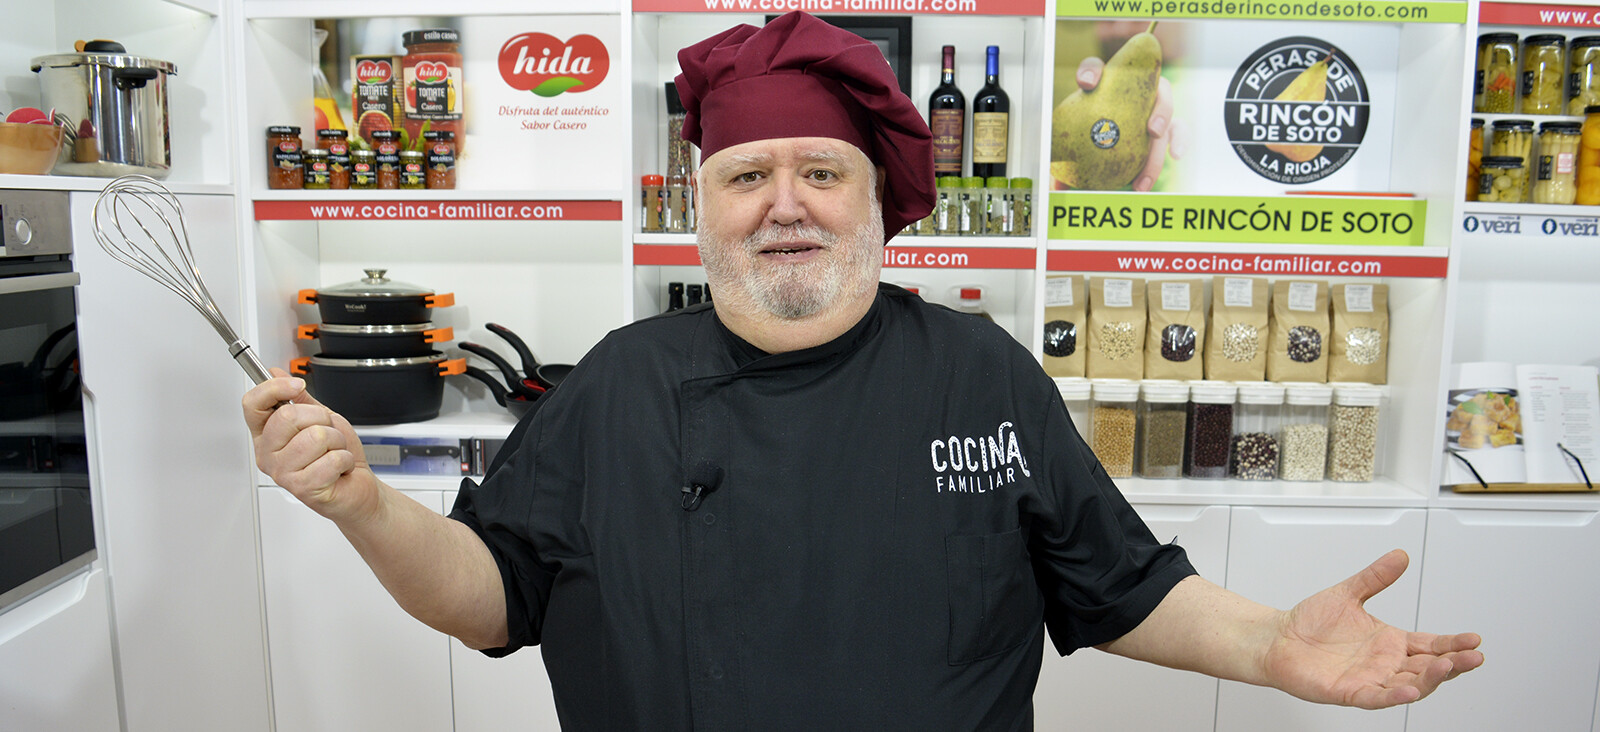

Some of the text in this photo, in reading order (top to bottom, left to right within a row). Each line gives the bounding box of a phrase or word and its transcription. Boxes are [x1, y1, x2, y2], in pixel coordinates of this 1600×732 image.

[1094, 0, 1428, 18] www.perasderincondesoto.com
[512, 45, 594, 75] hida
[359, 66, 387, 77] hida
[419, 66, 443, 77] hida
[1245, 49, 1354, 93] PERAS DE
[359, 85, 388, 96] TOMATE
[418, 87, 445, 98] TOMATE
[361, 101, 387, 110] Casero
[420, 103, 443, 111] Casero
[498, 105, 609, 118] Disfruta del auténtico
[1239, 100, 1356, 127] RINCÓN
[520, 119, 587, 130] Sabor Casero
[1252, 125, 1342, 143] DE SOTO
[1259, 154, 1332, 176] LA RIOJA
[309, 203, 564, 219] www.cocina-familiar.com
[1052, 203, 1414, 235] PERAS DE RINCÓN DE SOTO
[1481, 216, 1521, 234] veri
[1559, 218, 1599, 236] veri
[1117, 255, 1382, 274] www.cocina-familiar.com
[930, 421, 1031, 478] COCINA
[936, 467, 1016, 493] FAMILIAR
